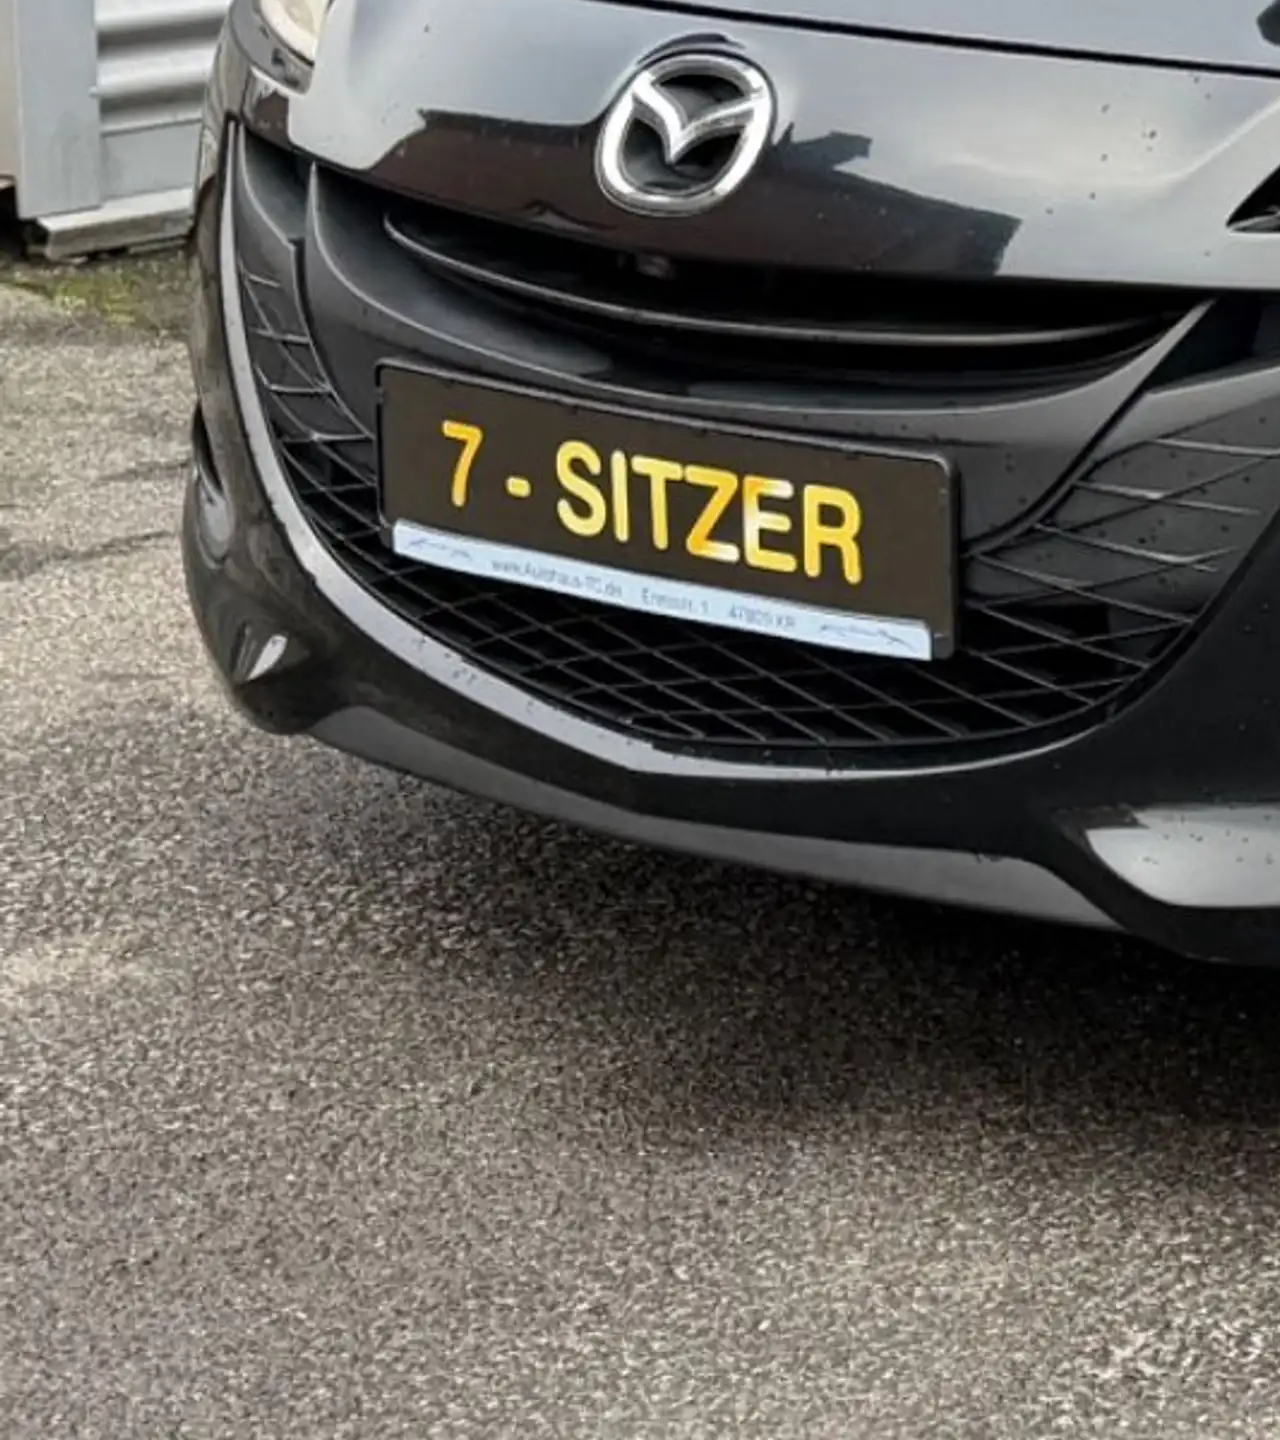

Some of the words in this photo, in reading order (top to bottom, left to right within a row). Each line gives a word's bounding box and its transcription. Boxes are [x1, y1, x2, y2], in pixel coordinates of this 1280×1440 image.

[442, 420, 483, 507] 7
[506, 474, 532, 499] -
[554, 439, 865, 586] SITZER
